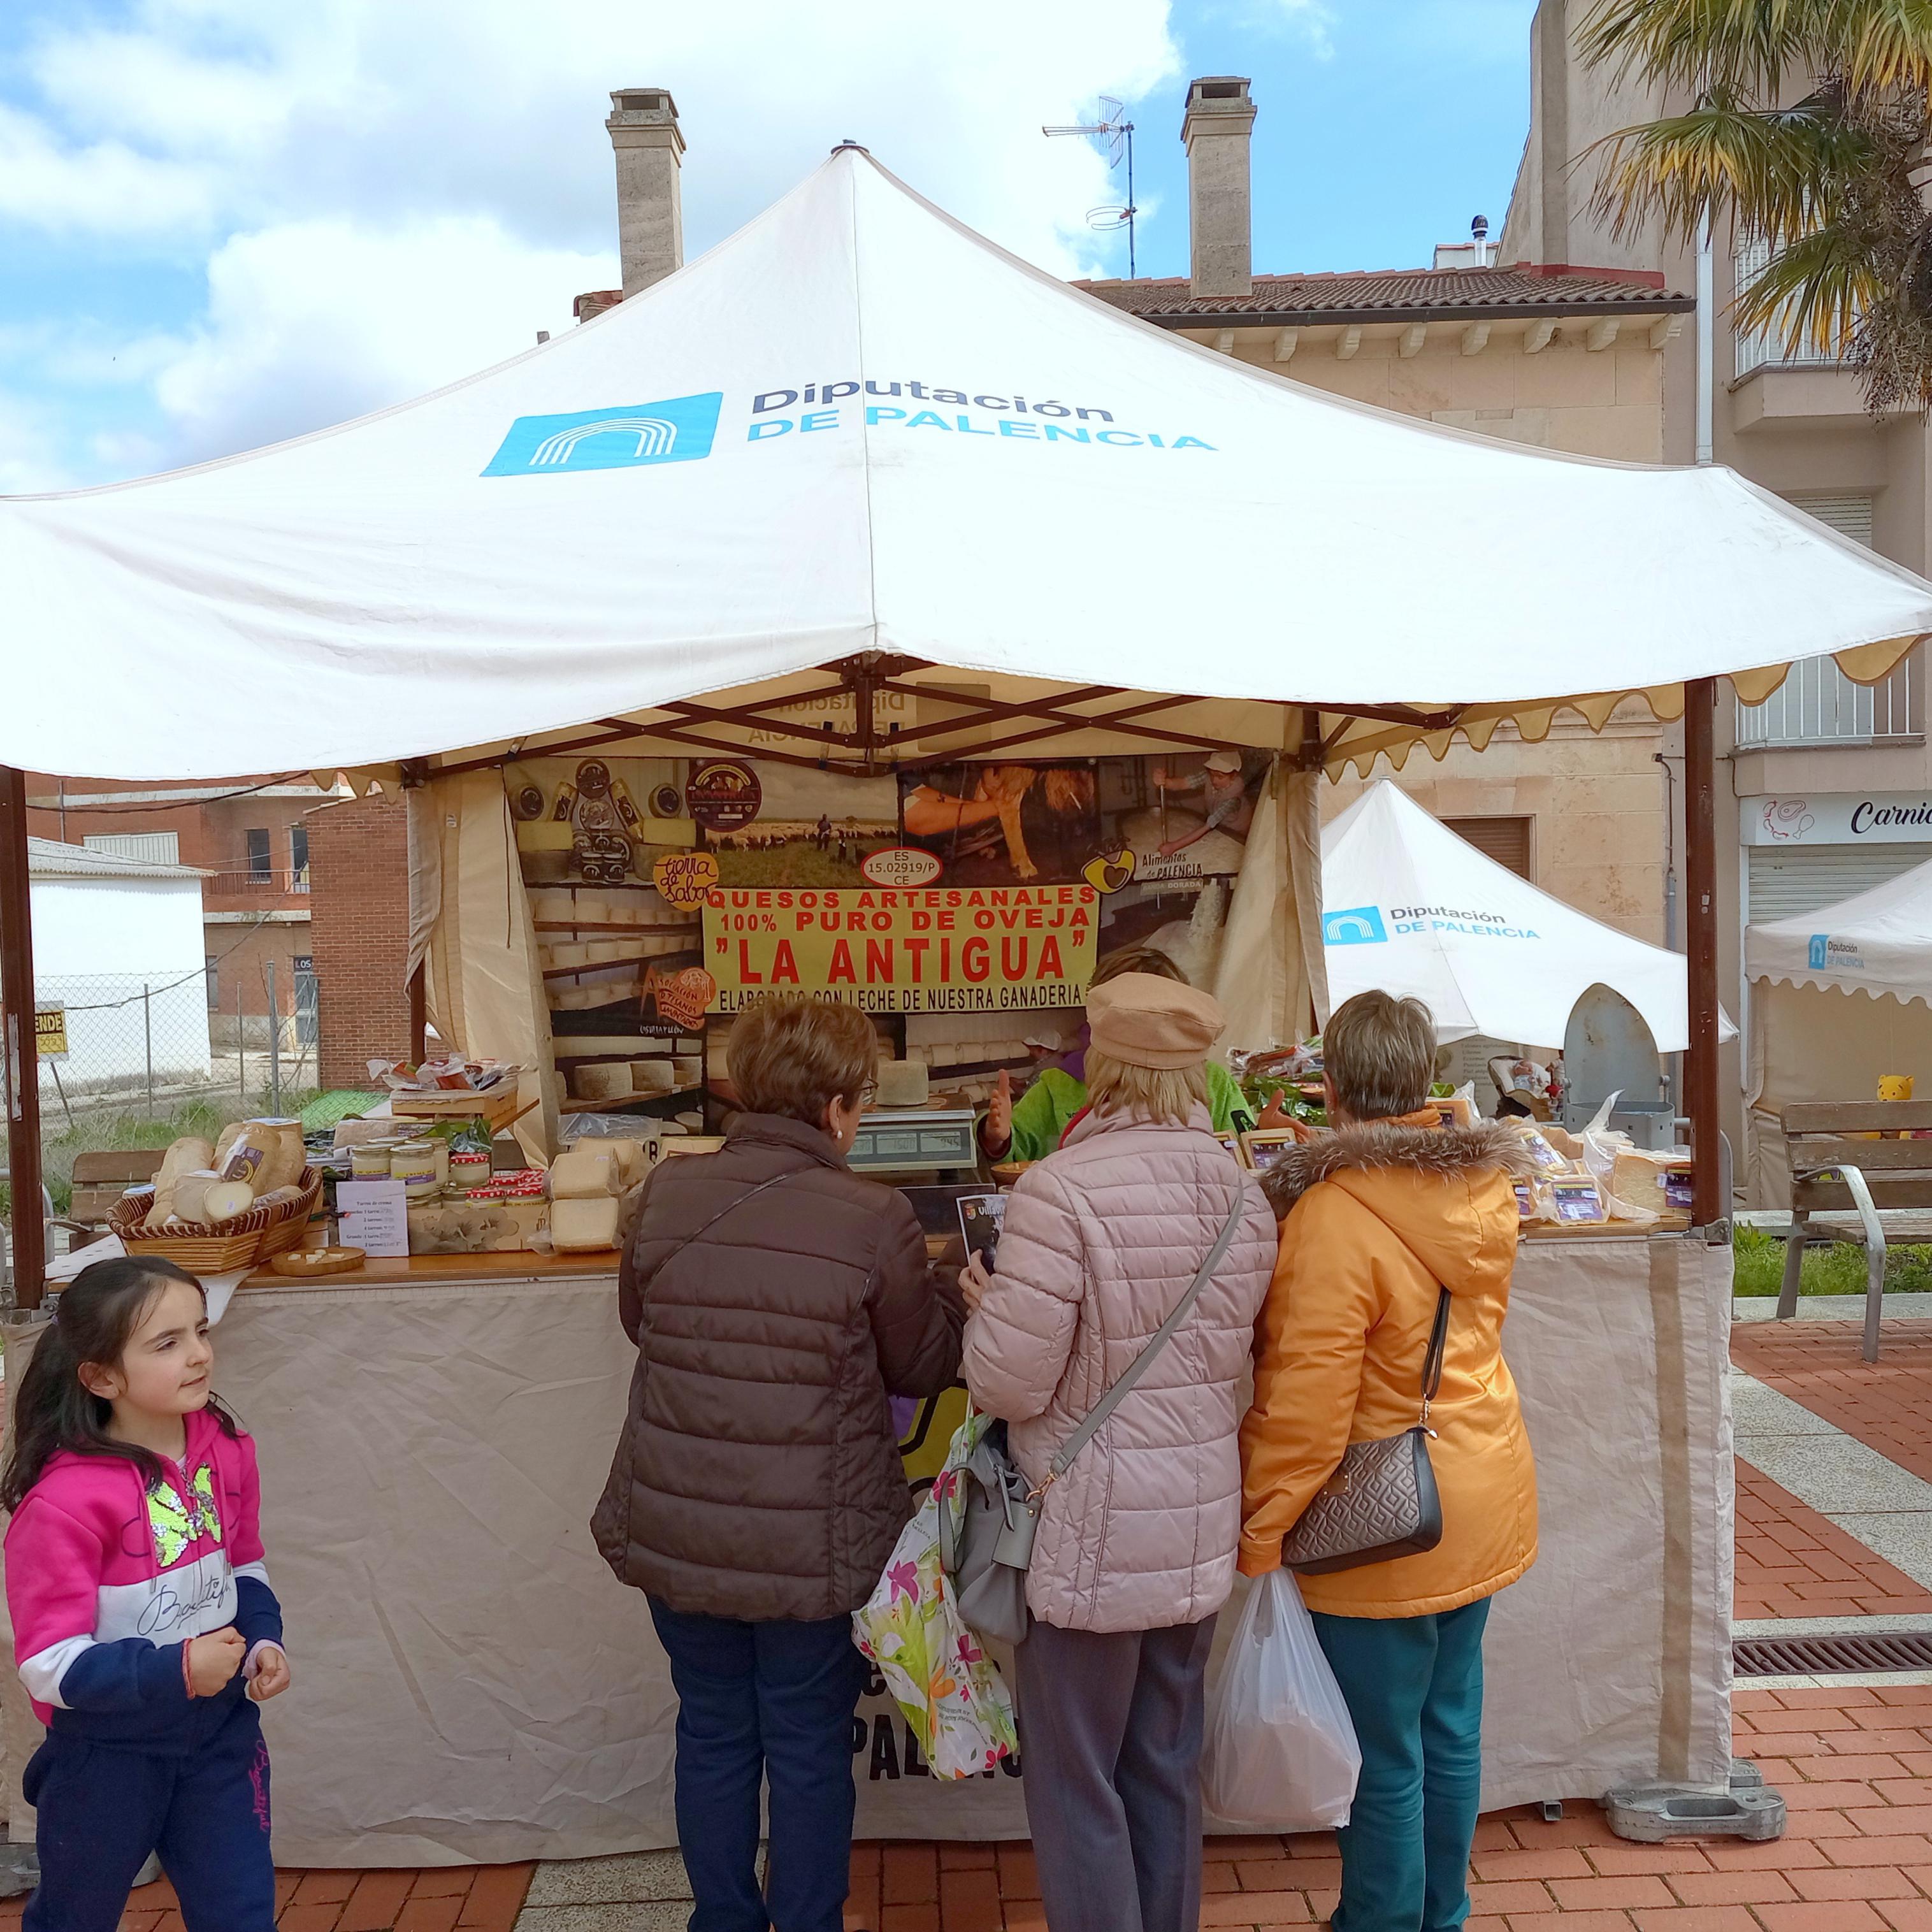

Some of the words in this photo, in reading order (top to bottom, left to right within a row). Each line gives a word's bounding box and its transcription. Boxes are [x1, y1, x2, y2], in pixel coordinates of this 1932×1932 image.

[753, 380, 1114, 422] Diputación
[747, 410, 839, 442] DE
[866, 407, 1220, 451] PALENCIA
[895, 852, 908, 861] ES
[1143, 854, 1186, 867] Alimentos
[655, 858, 717, 877] tierra
[869, 862, 935, 874] 15.02919/P
[1157, 863, 1202, 879] PALENCIA
[665, 875, 717, 903] sabor
[894, 876, 909, 885] CE
[707, 891, 839, 909] QUESOS
[857, 886, 1095, 908] ARTESANALES
[721, 914, 777, 932] 100%
[797, 911, 893, 932] PURO
[912, 911, 955, 930] DE
[974, 907, 1089, 929] OVEJA
[1390, 906, 1506, 924] Diputación
[1395, 921, 1426, 934] DE
[1432, 921, 1541, 939] PALENCIA
[1828, 941, 1857, 954] Diputación
[1827, 955, 1835, 965] DE
[1836, 956, 1864, 969] PALENCIA
[903, 990, 920, 1010] DE
[928, 988, 994, 1009] NUESTRA
[1000, 984, 1081, 1007] GANADERIA
[35, 1014, 62, 1032] ENDE
